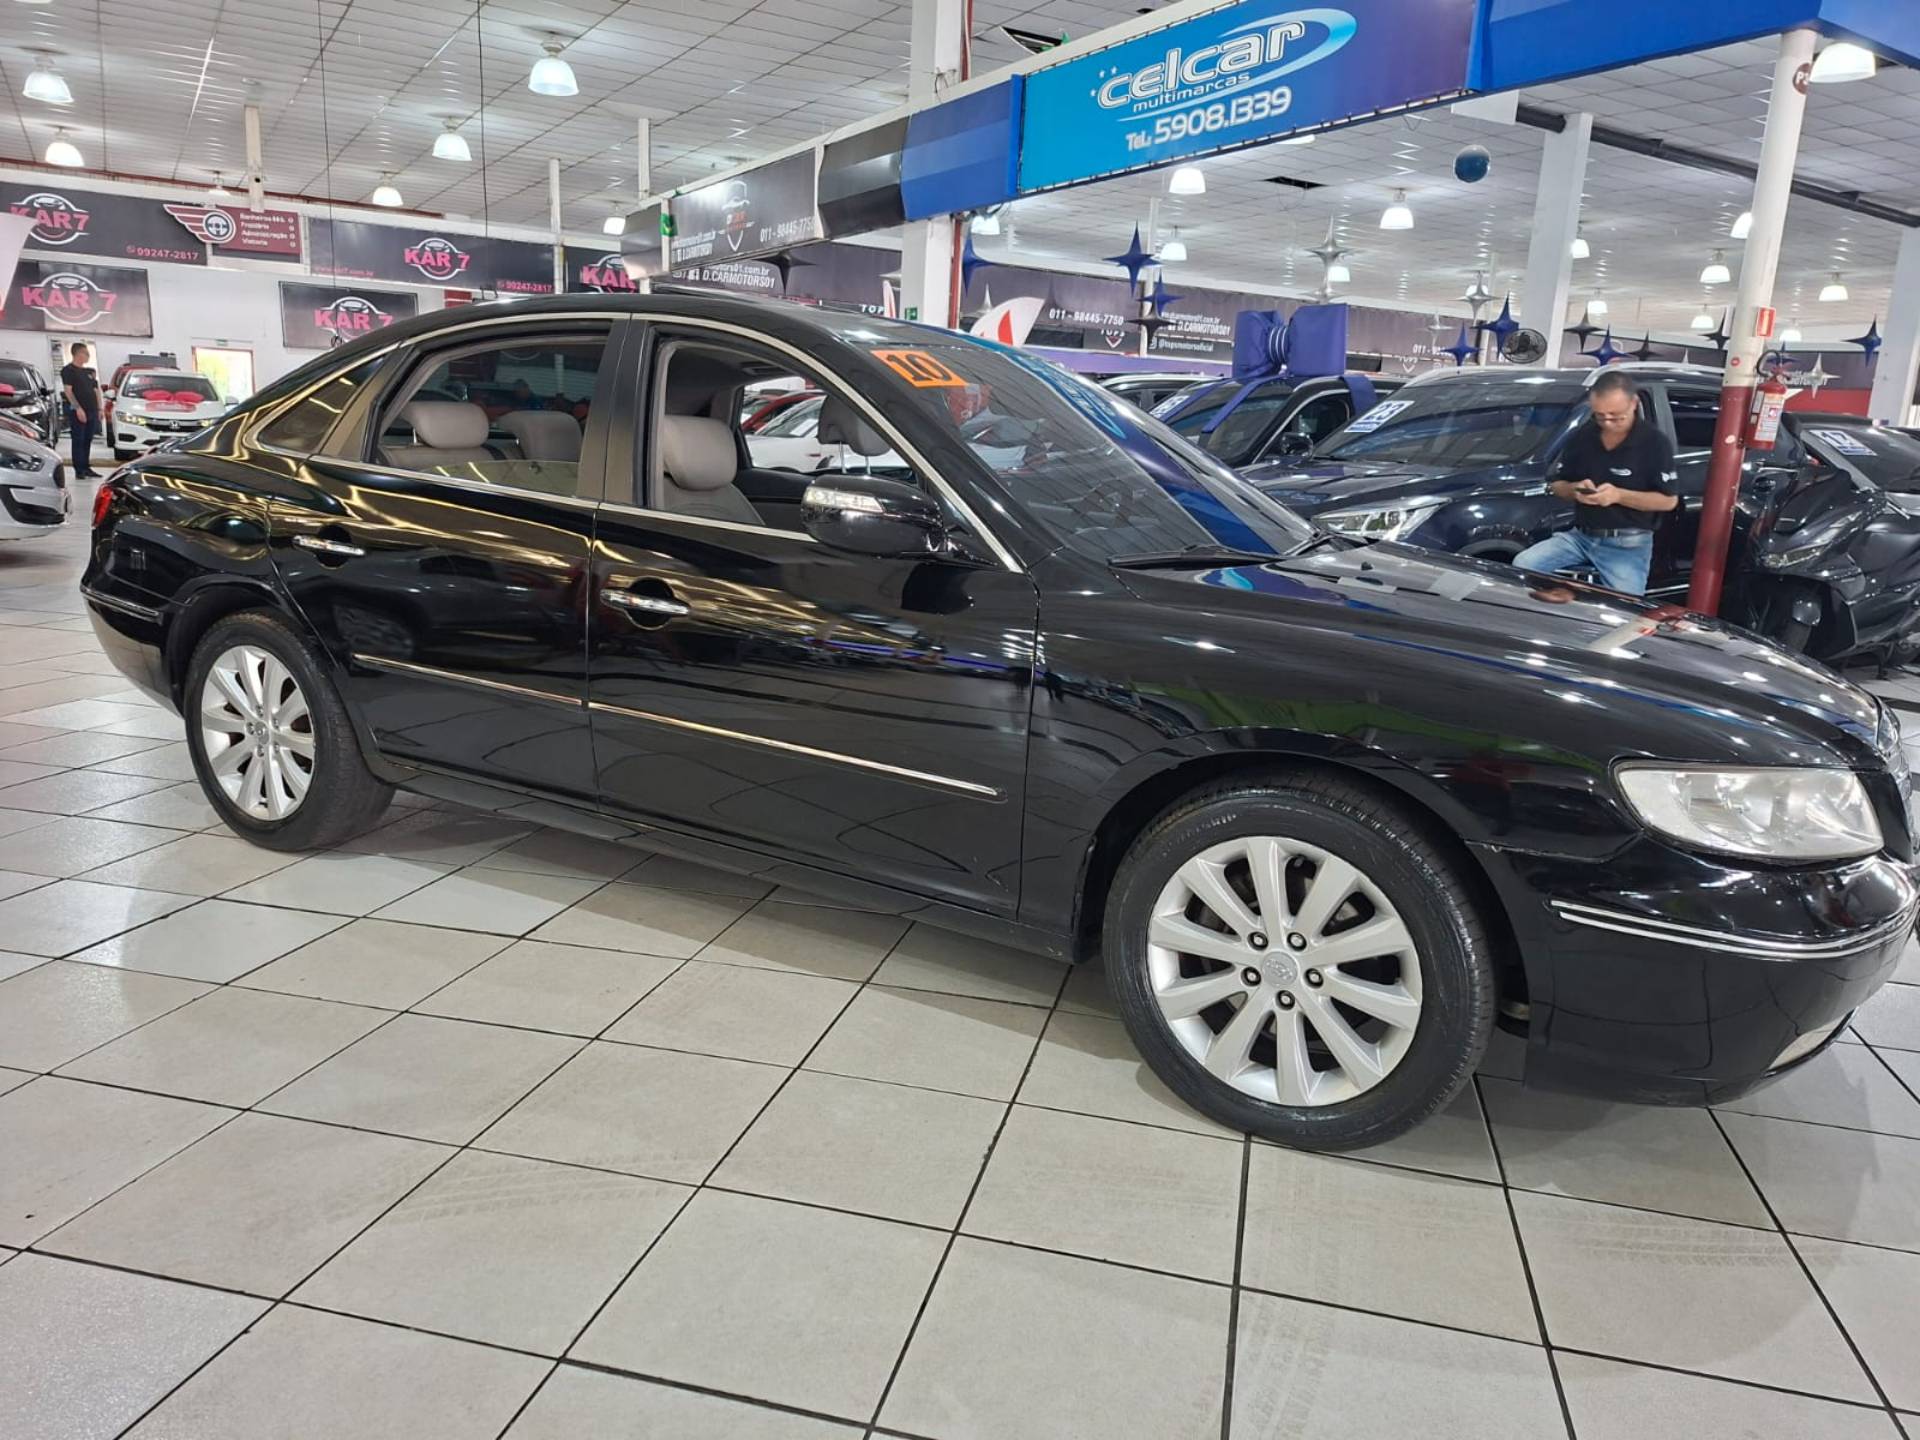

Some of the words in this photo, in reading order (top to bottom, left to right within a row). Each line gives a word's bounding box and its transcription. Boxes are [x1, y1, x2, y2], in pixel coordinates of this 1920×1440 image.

[1098, 20, 1305, 109] celcar
[1132, 73, 1250, 112] multimarcas
[1154, 86, 1292, 145] 5908.1339
[137, 246, 199, 261] 99247-2817
[403, 247, 451, 269] KAR
[458, 253, 470, 269] 7
[702, 269, 776, 288] D.CARMOTORS01
[22, 286, 92, 311] KAR
[99, 292, 118, 311] 7
[314, 308, 371, 330] KAR
[1049, 308, 1066, 320] 011
[1074, 311, 1124, 326] 98445-7750
[886, 353, 952, 382] 10
